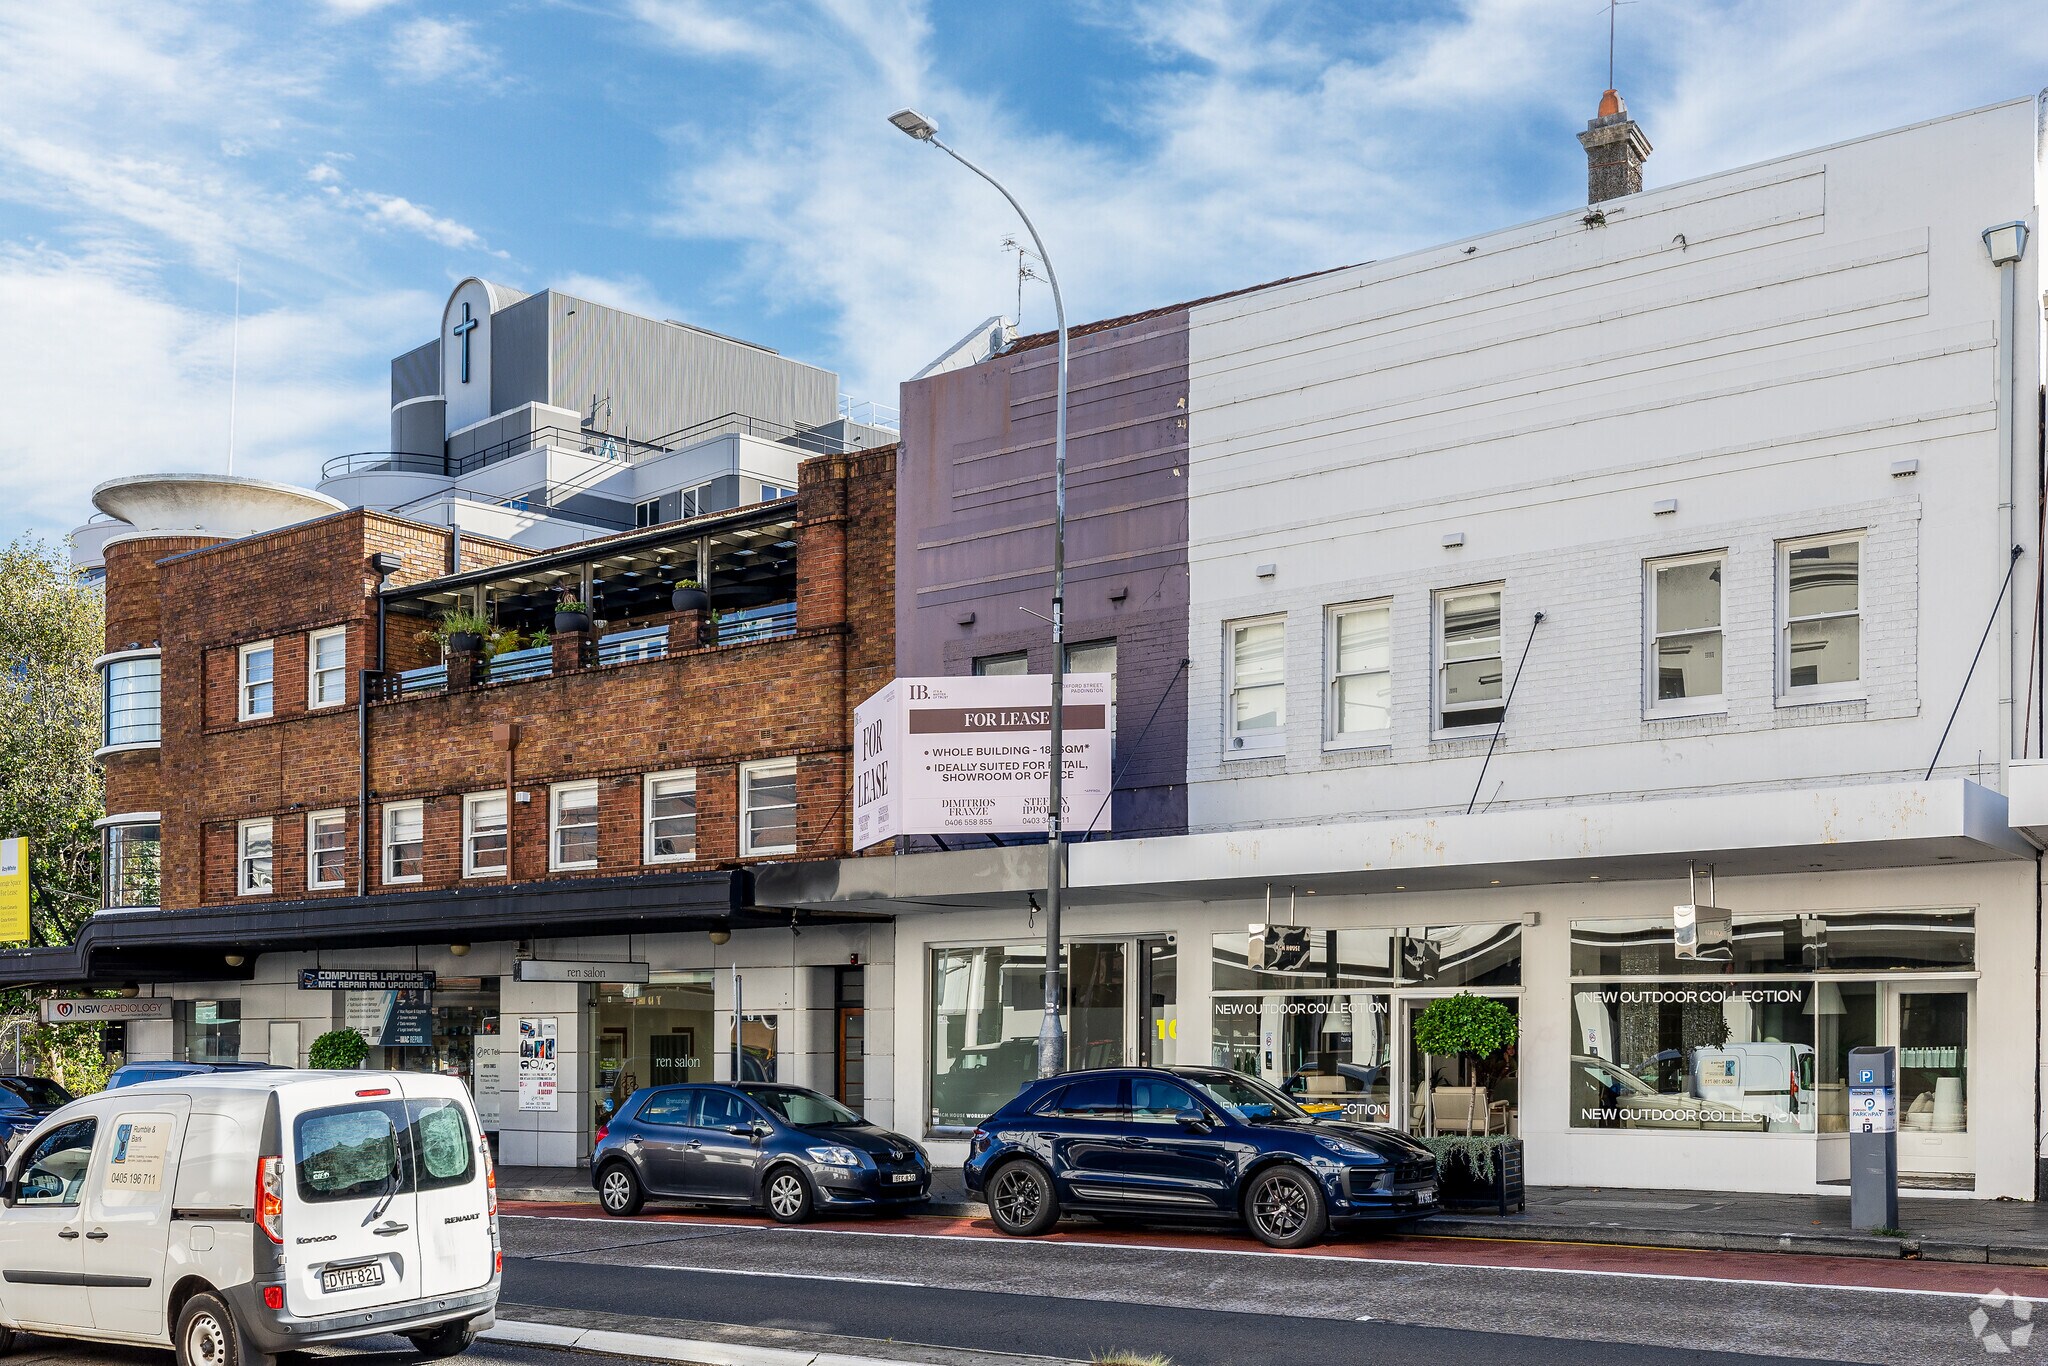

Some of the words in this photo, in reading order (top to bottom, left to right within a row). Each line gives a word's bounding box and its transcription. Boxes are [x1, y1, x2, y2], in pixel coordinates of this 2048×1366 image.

[909, 685, 931, 700] IB.
[964, 712, 997, 727] FOR
[1000, 711, 1050, 726] LEASE
[862, 718, 883, 762] FOR
[932, 748, 973, 757] WHOLE
[976, 746, 1030, 756] BUILDING
[1040, 746, 1051, 754] 18
[934, 763, 977, 772] IDEALLY
[979, 761, 1020, 771] SUITED
[1022, 761, 1045, 770] FOR
[1048, 760, 1088, 770] TAIL,
[942, 772, 1012, 782] SHOWROOM
[1015, 771, 1031, 780] OR
[1033, 770, 1075, 780] OFCE
[858, 760, 888, 808] LEASE
[942, 798, 996, 808] DIMITRIOS
[949, 807, 989, 816] FRANZE
[979, 818, 993, 826] 855
[1022, 817, 1040, 825] 0403
[318, 971, 378, 980] COMPUTERS
[380, 972, 424, 981] LAPTOPS
[567, 969, 581, 978] ren
[583, 966, 606, 978] salon
[318, 980, 337, 988] MAC
[339, 981, 368, 989] REPAIR
[369, 981, 386, 989] AND
[387, 981, 424, 989] UPGRADE
[1582, 992, 1618, 1004] NEW
[1620, 991, 1697, 1003] OUTDOOR
[1699, 990, 1801, 1003] COLLECTION
[1215, 1003, 1243, 1015] NEW
[1245, 1003, 1306, 1014] OUTDOOR
[1307, 1002, 1388, 1014] COLLECTION
[655, 1056, 672, 1068] ren
[674, 1054, 701, 1068] salon
[1582, 1108, 1617, 1120] NEW
[1619, 1108, 1697, 1121] OUTDOOR
[1699, 1110, 1801, 1123] COLLECTION
[133, 1126, 151, 1134] Rumble
[111, 1172, 128, 1183] 0405
[129, 1173, 142, 1184] 196
[143, 1173, 156, 1184] 711
[444, 1213, 480, 1225] RENAULT
[296, 1234, 337, 1245] Kangoo
